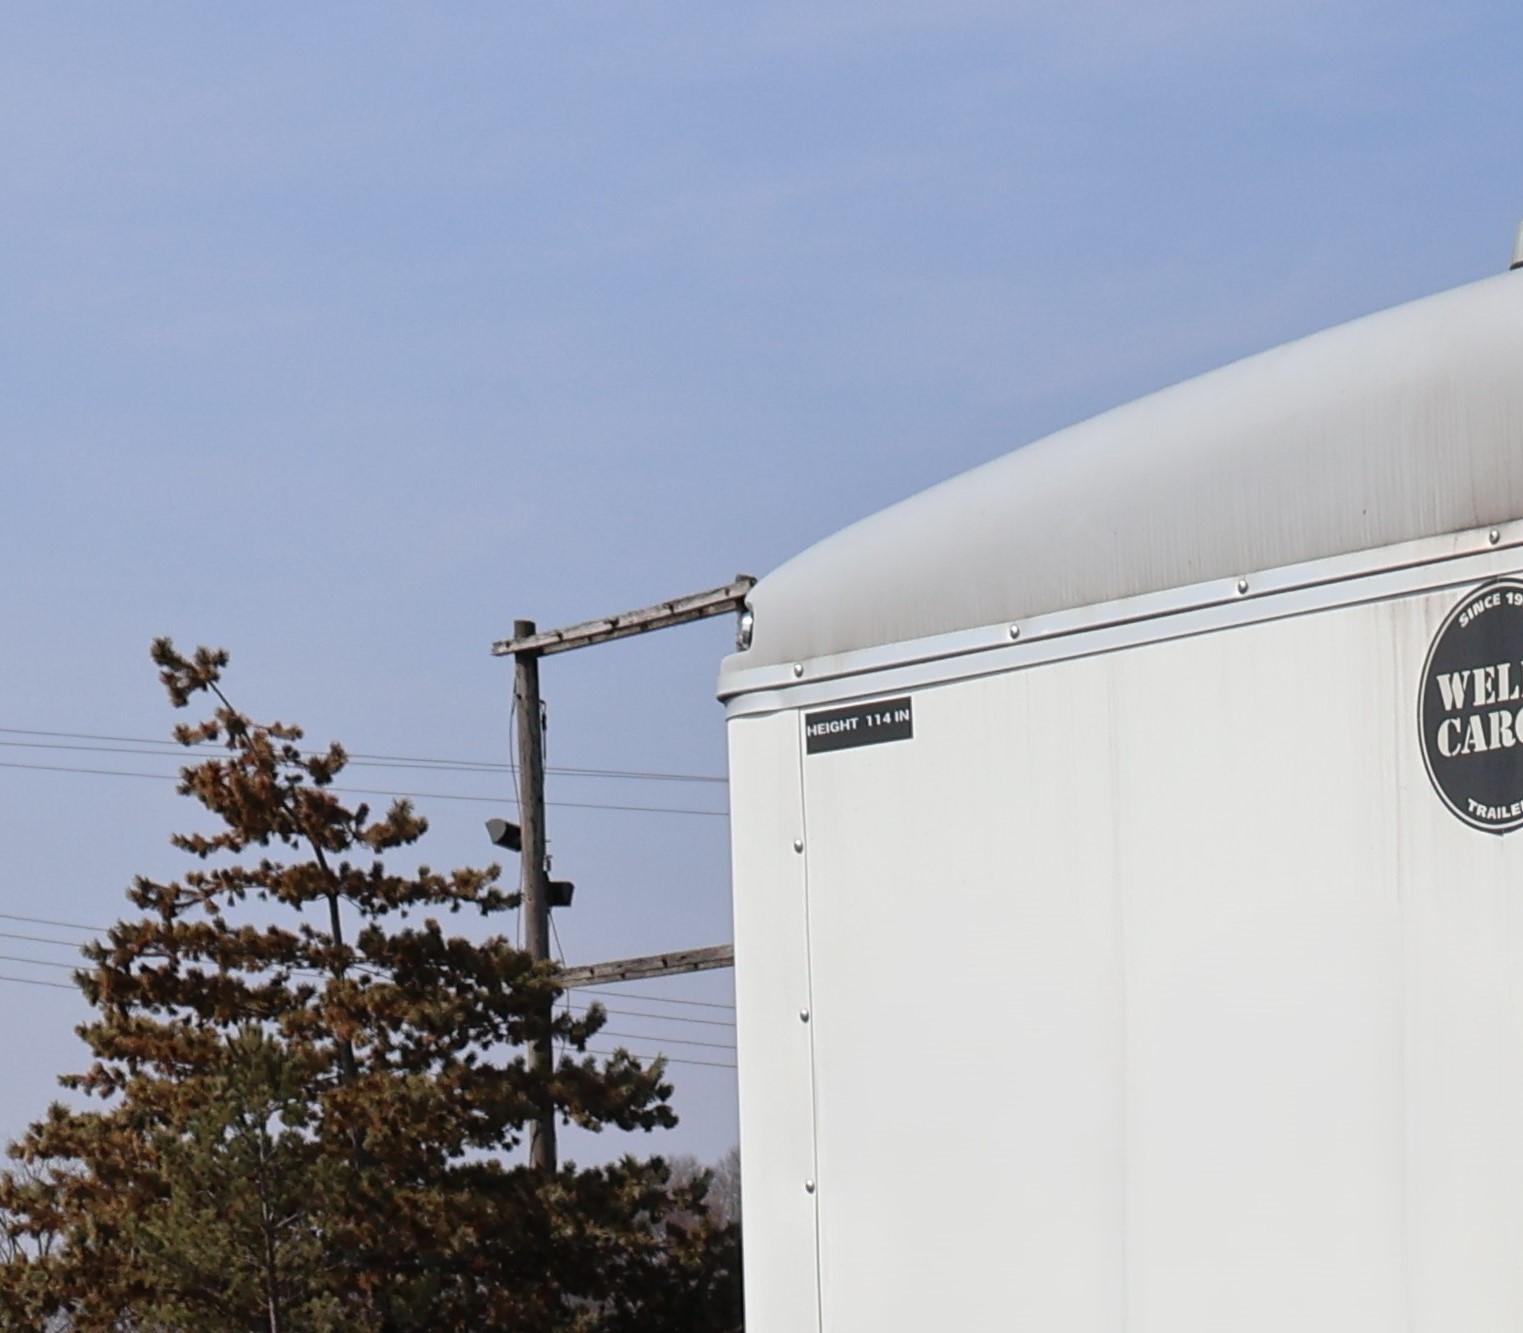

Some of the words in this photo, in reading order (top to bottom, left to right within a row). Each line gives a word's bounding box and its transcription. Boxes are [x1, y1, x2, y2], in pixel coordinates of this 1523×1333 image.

[1458, 592, 1501, 628] SINCE
[807, 717, 859, 737] HEIGHT
[866, 712, 891, 727] 114
[895, 709, 910, 722] IN
